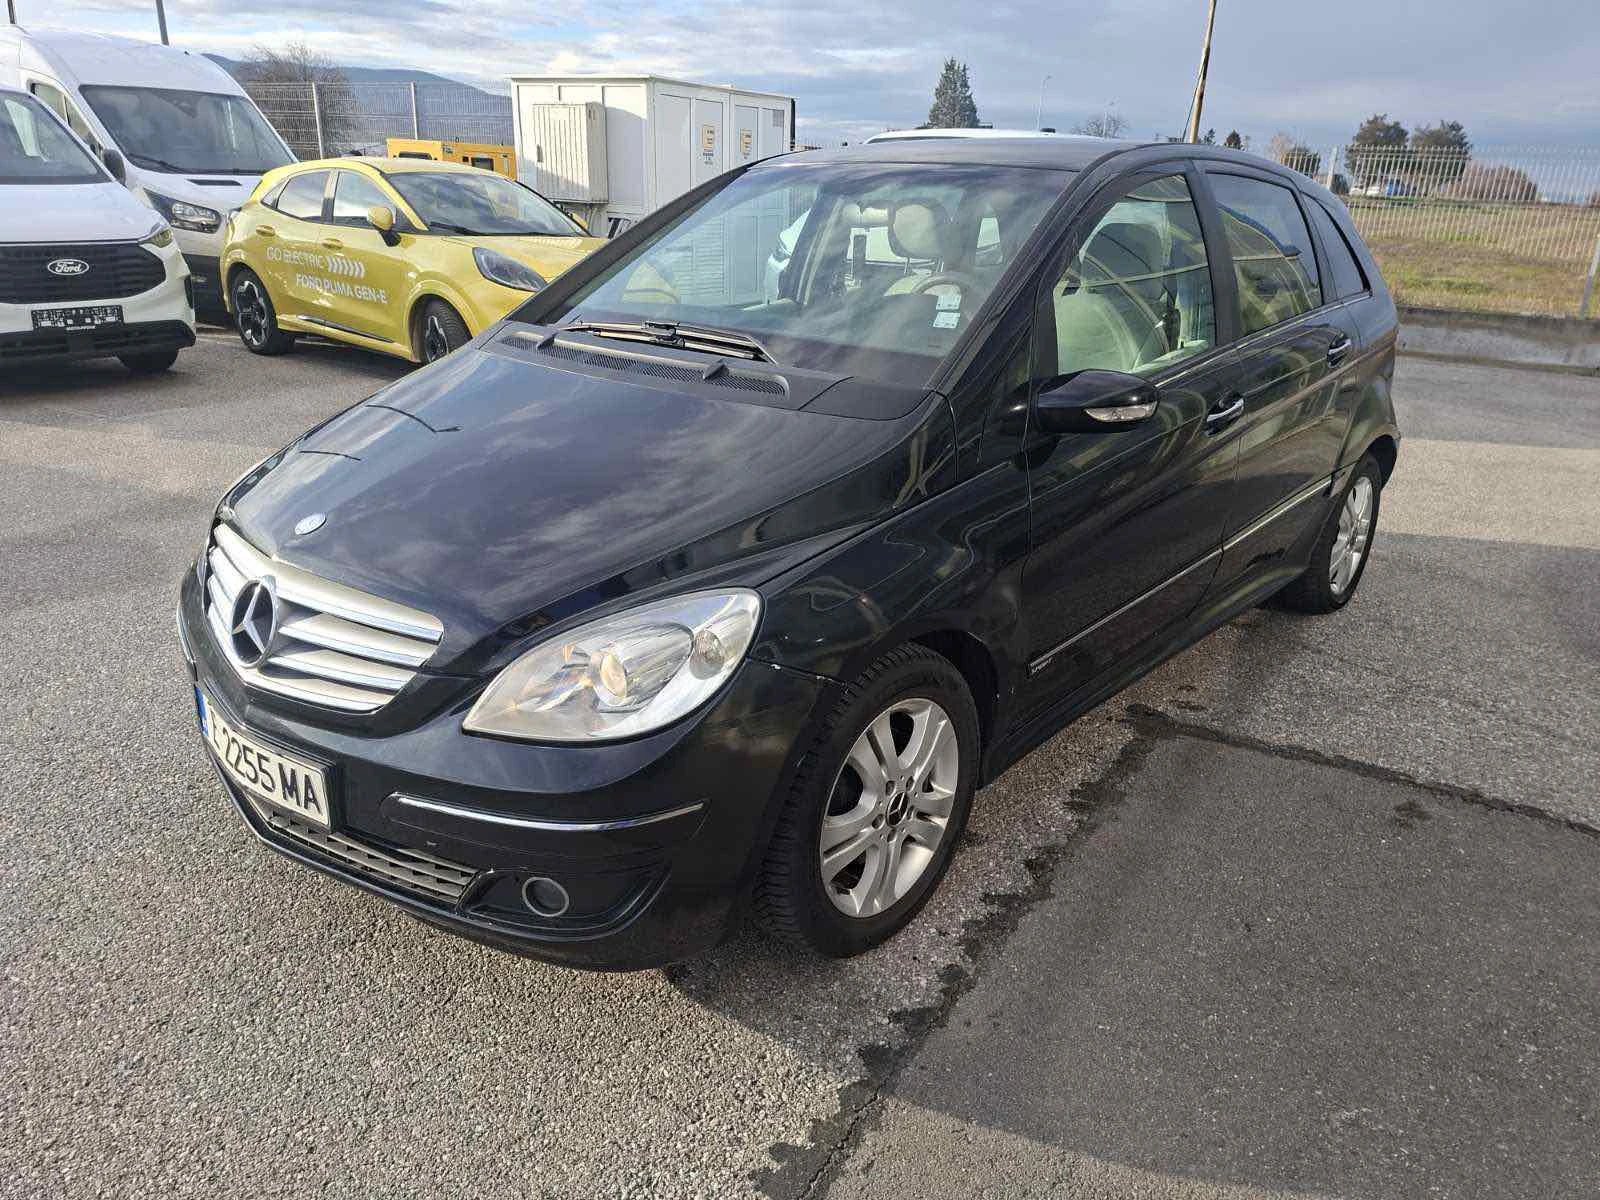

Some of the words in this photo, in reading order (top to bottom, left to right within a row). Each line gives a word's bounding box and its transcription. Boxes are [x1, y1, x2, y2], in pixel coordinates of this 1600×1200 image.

[53, 261, 83, 273] Ford
[266, 246, 282, 261] GO
[283, 251, 324, 269] ELECTRIC
[296, 273, 323, 290] FORD
[324, 280, 354, 298] PUMA
[354, 285, 389, 304] GEN-E
[222, 726, 276, 793] 2255
[278, 761, 322, 815] MA
